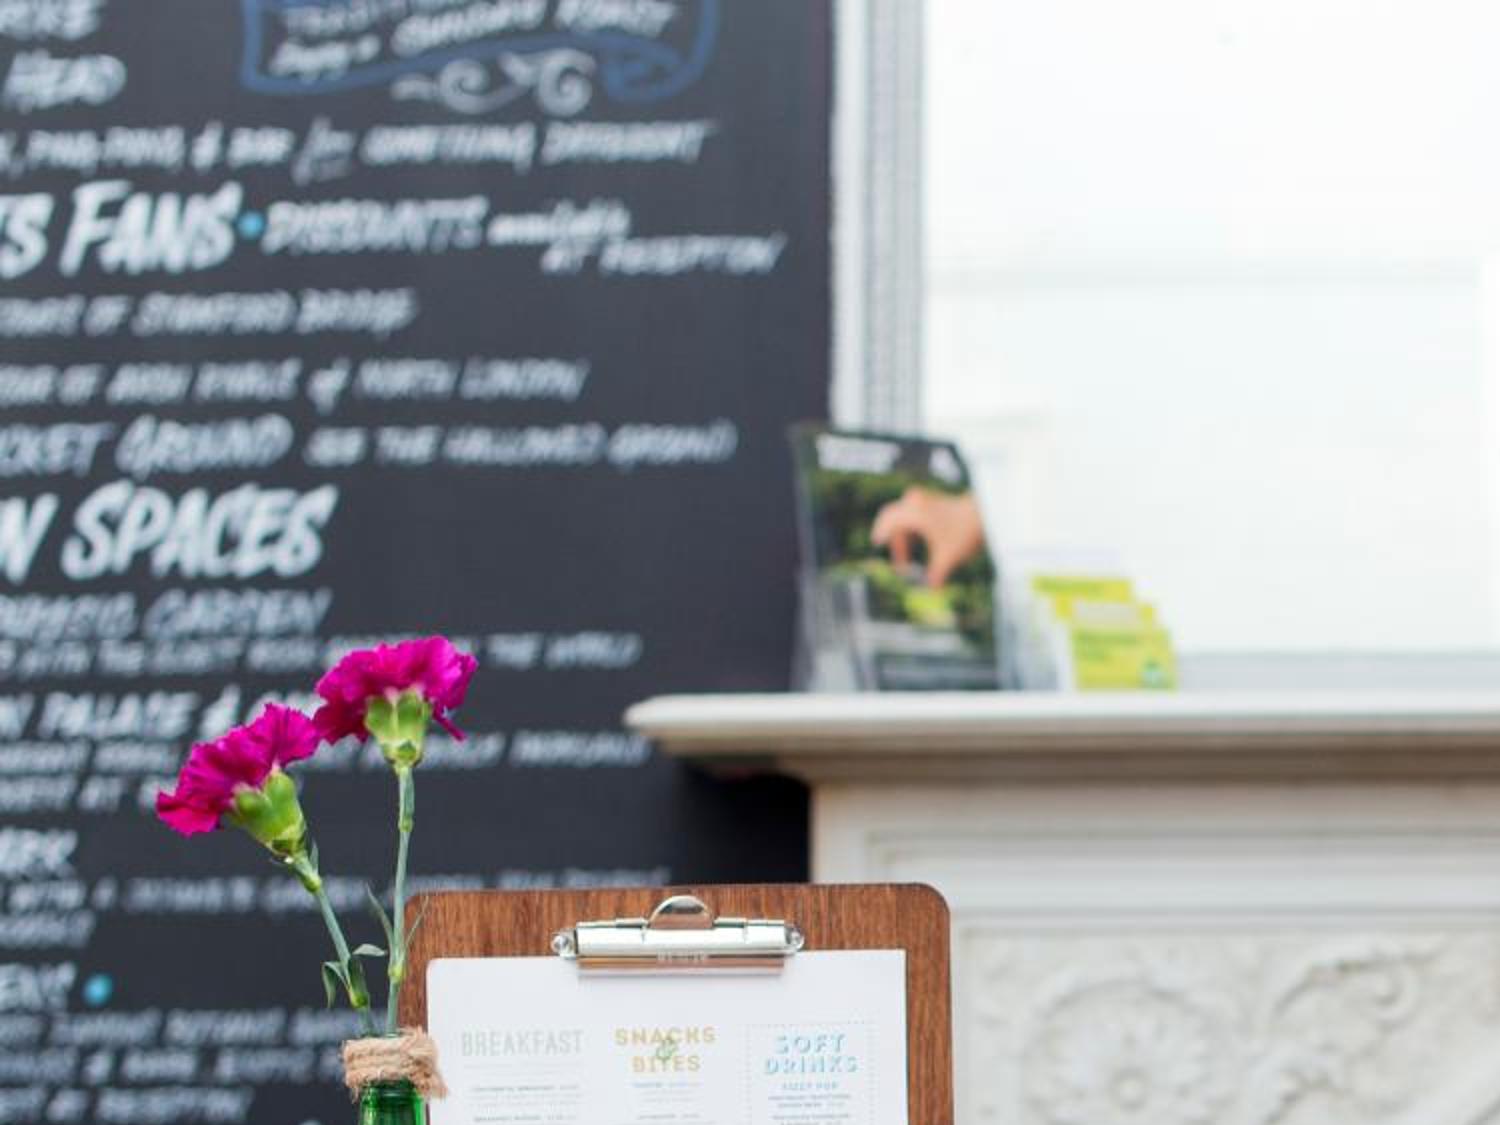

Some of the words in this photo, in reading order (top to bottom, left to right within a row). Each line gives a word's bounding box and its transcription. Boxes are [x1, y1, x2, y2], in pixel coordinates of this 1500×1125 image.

[0, 193, 53, 278] TS
[58, 180, 242, 275] FANS
[0, 422, 113, 476] CKET
[0, 490, 58, 585] N
[61, 479, 340, 580] SPACES
[461, 1028, 584, 1057] BREAKFAST
[615, 1026, 716, 1047] SNACKS
[775, 1034, 846, 1055] SOFT
[633, 1054, 701, 1074] BITES
[764, 1055, 860, 1076] DRINKS
